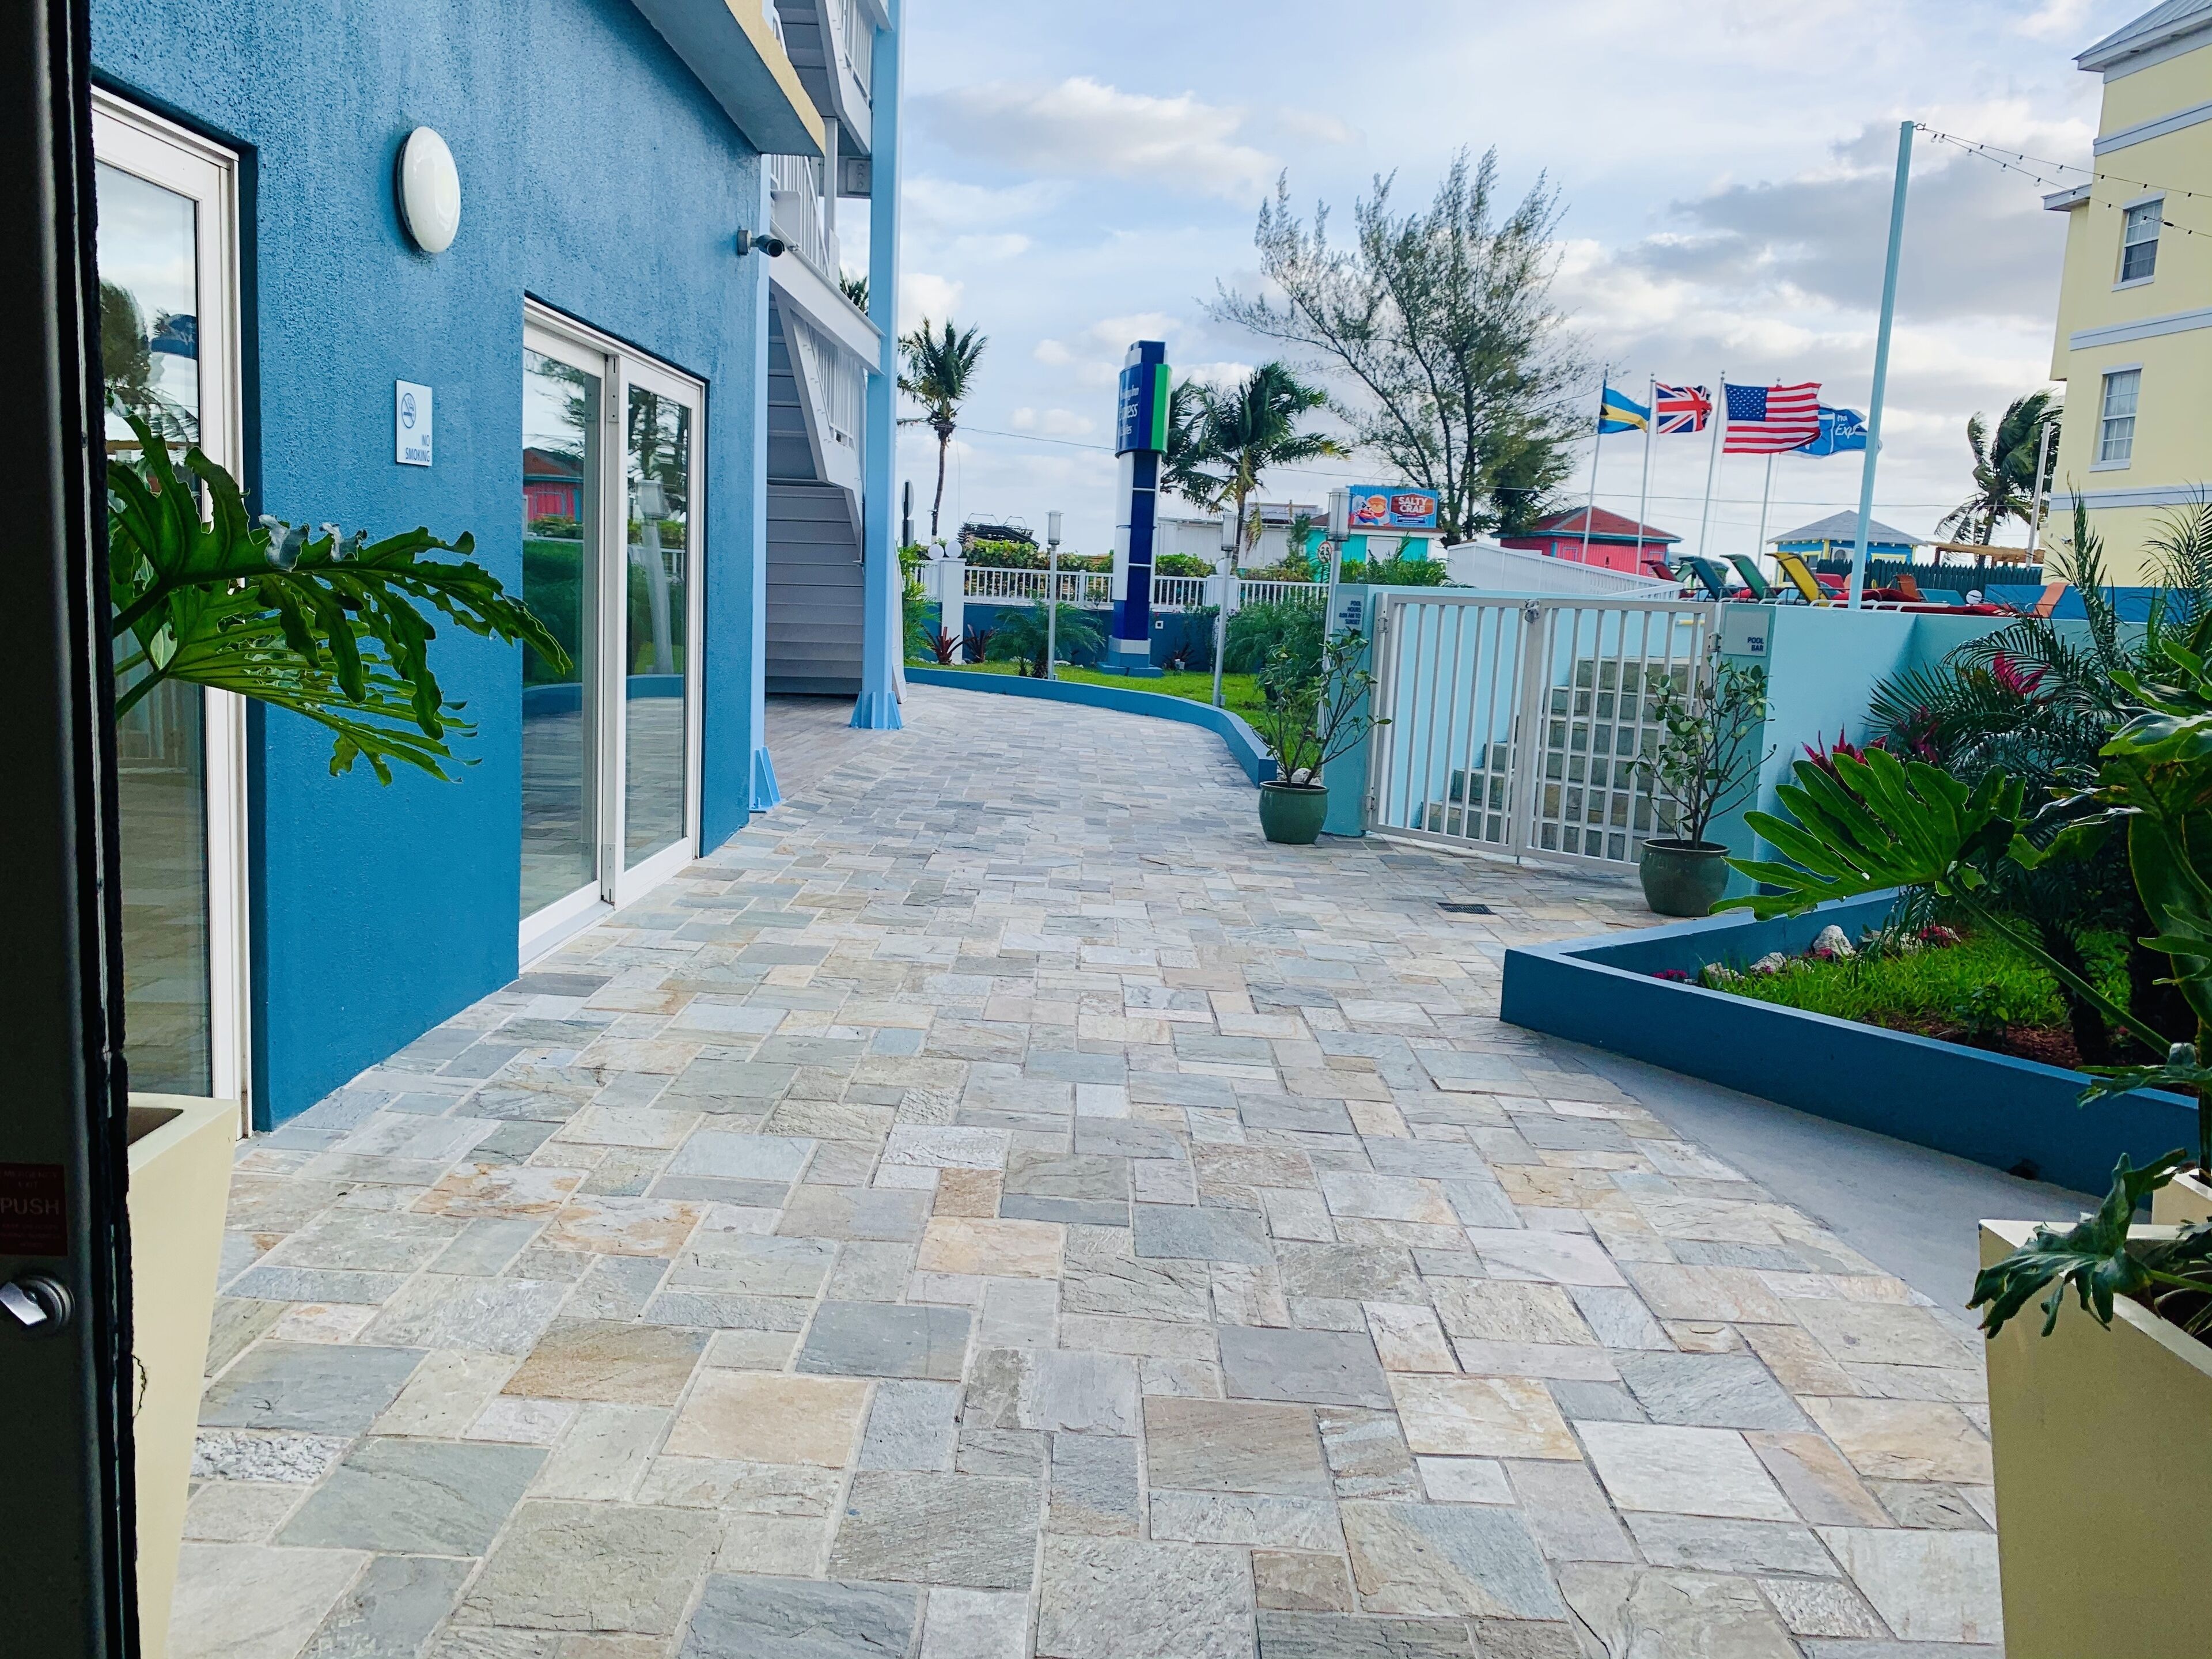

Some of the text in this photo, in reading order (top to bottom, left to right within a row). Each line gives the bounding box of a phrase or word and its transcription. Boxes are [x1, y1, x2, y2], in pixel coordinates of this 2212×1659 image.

[422, 434, 430, 447] NO
[406, 448, 430, 462] SMOKING
[1398, 497, 1429, 506] SALTY
[1399, 505, 1426, 513] CRAB
[0, 1169, 57, 1179] MERGENCY
[0, 1197, 59, 1215] PUSH
